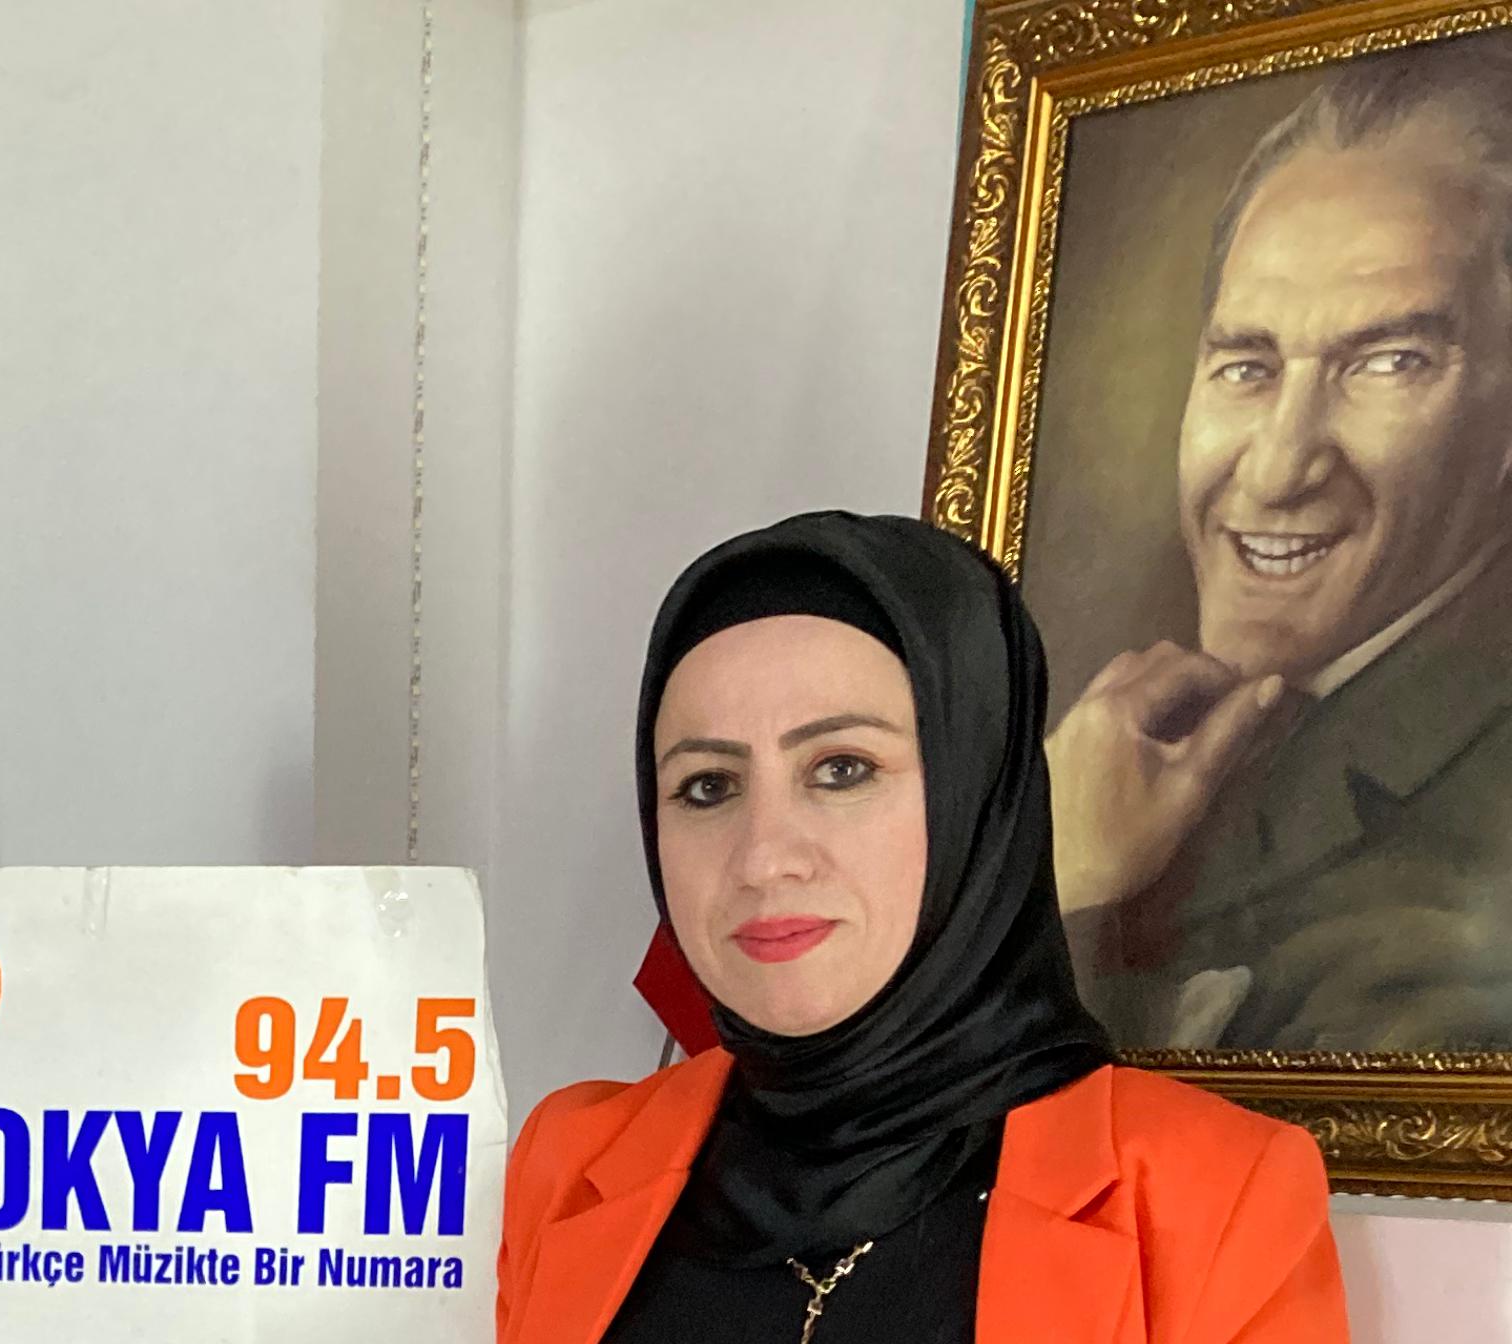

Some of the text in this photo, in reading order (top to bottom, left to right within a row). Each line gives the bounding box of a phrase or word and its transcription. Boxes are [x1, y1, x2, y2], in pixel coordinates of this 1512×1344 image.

[233, 995, 477, 1102] 94.5
[296, 1111, 470, 1237] FM
[98, 1244, 241, 1287] Müzikte
[253, 1246, 307, 1287] Bir
[317, 1247, 464, 1290] Numara
